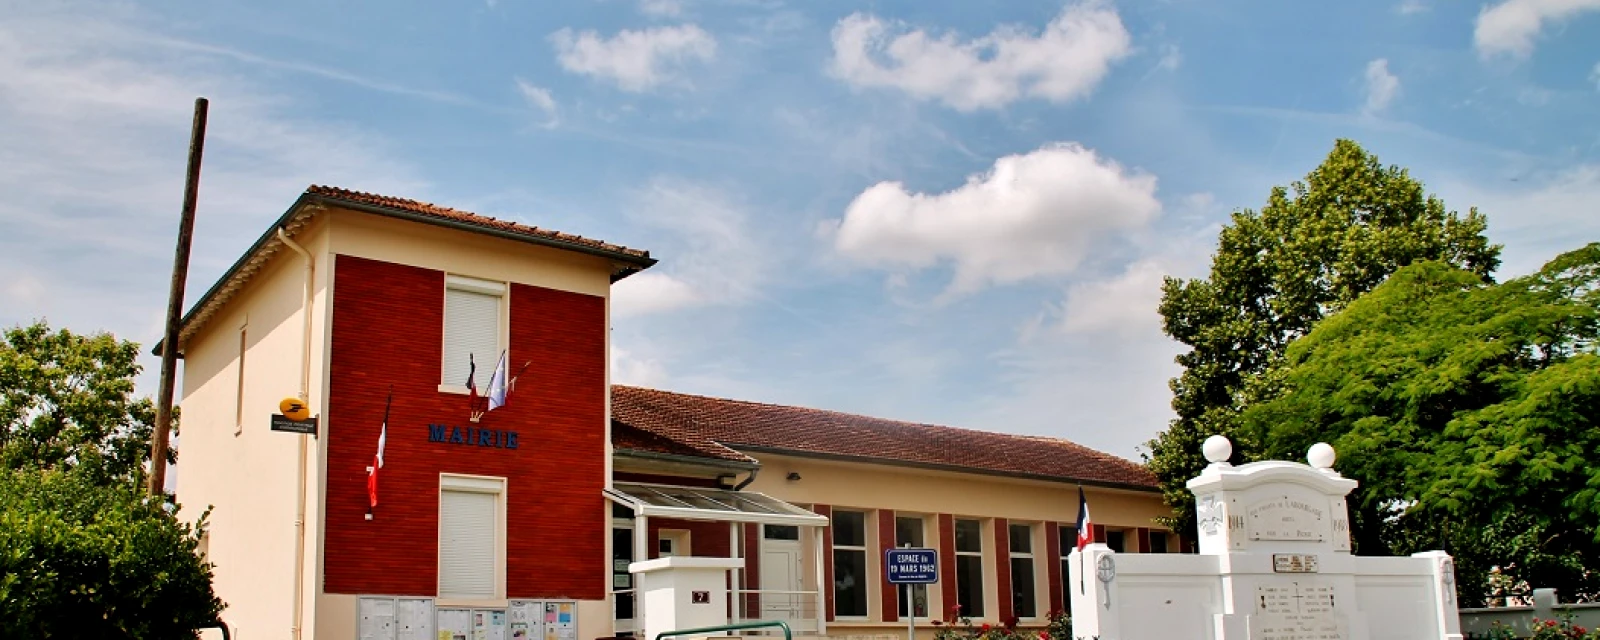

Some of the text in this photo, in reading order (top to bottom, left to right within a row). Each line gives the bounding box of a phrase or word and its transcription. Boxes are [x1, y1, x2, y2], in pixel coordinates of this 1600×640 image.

[428, 423, 518, 449] MAIRIE
[897, 554, 919, 563] ESPACE
[890, 563, 935, 573] 19 MARS 1962
